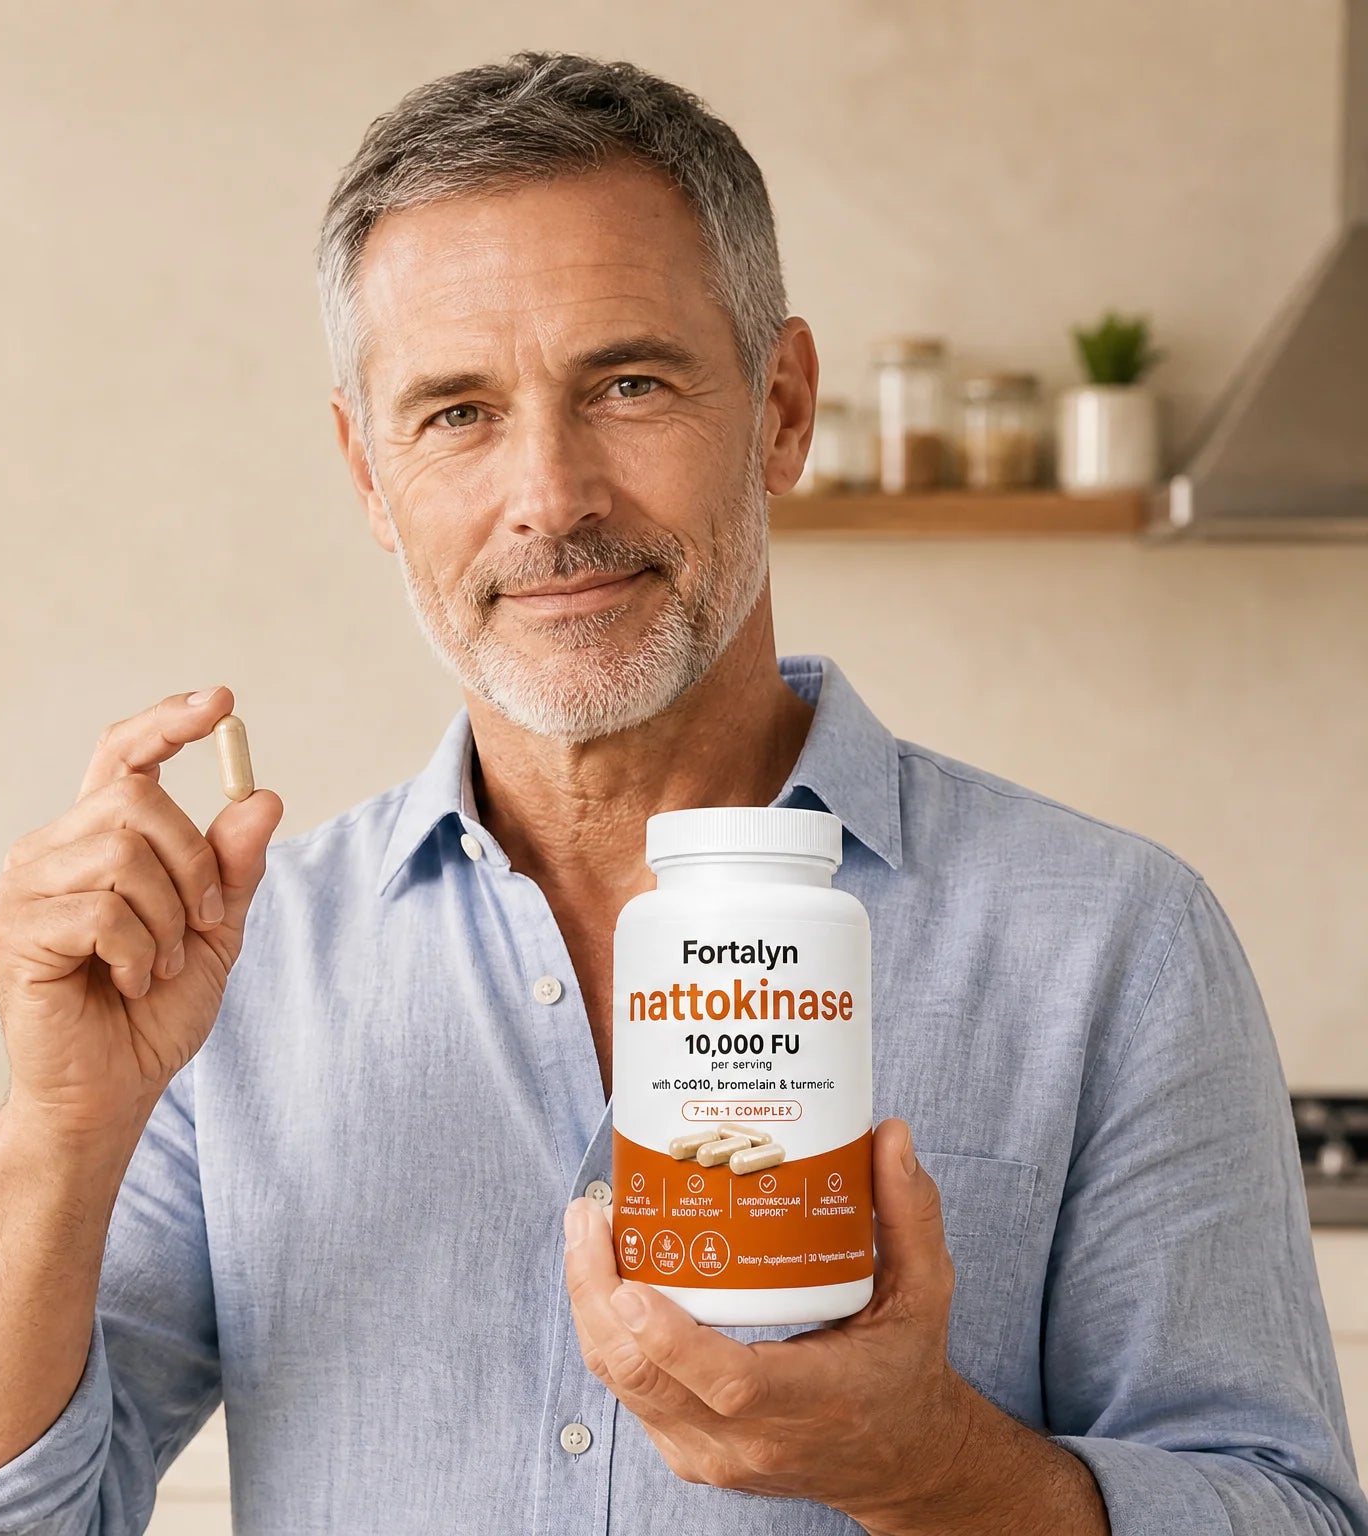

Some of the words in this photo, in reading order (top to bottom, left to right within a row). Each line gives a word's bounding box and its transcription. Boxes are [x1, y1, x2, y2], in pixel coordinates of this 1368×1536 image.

[683, 939, 799, 971] Fortalyn
[629, 978, 853, 1022] nattokinase
[685, 1034, 764, 1057] 10,000
[771, 1034, 800, 1055] FU
[711, 1060, 729, 1071] per
[732, 1059, 773, 1071] serving
[652, 1079, 671, 1090] with
[673, 1079, 714, 1092] CoQ10,
[717, 1079, 776, 1090] bromelain
[780, 1079, 788, 1090] &
[790, 1078, 835, 1090] turmeric
[693, 1106, 731, 1116] 7-IN-1
[735, 1106, 793, 1116] COMPLEX
[679, 1197, 713, 1206] HEALTHY
[820, 1195, 849, 1205] HEALTHY
[671, 1208, 697, 1217] BLOOD
[737, 1255, 762, 1266] Dietary
[763, 1254, 802, 1266] Supplement
[808, 1253, 817, 1263] 30
